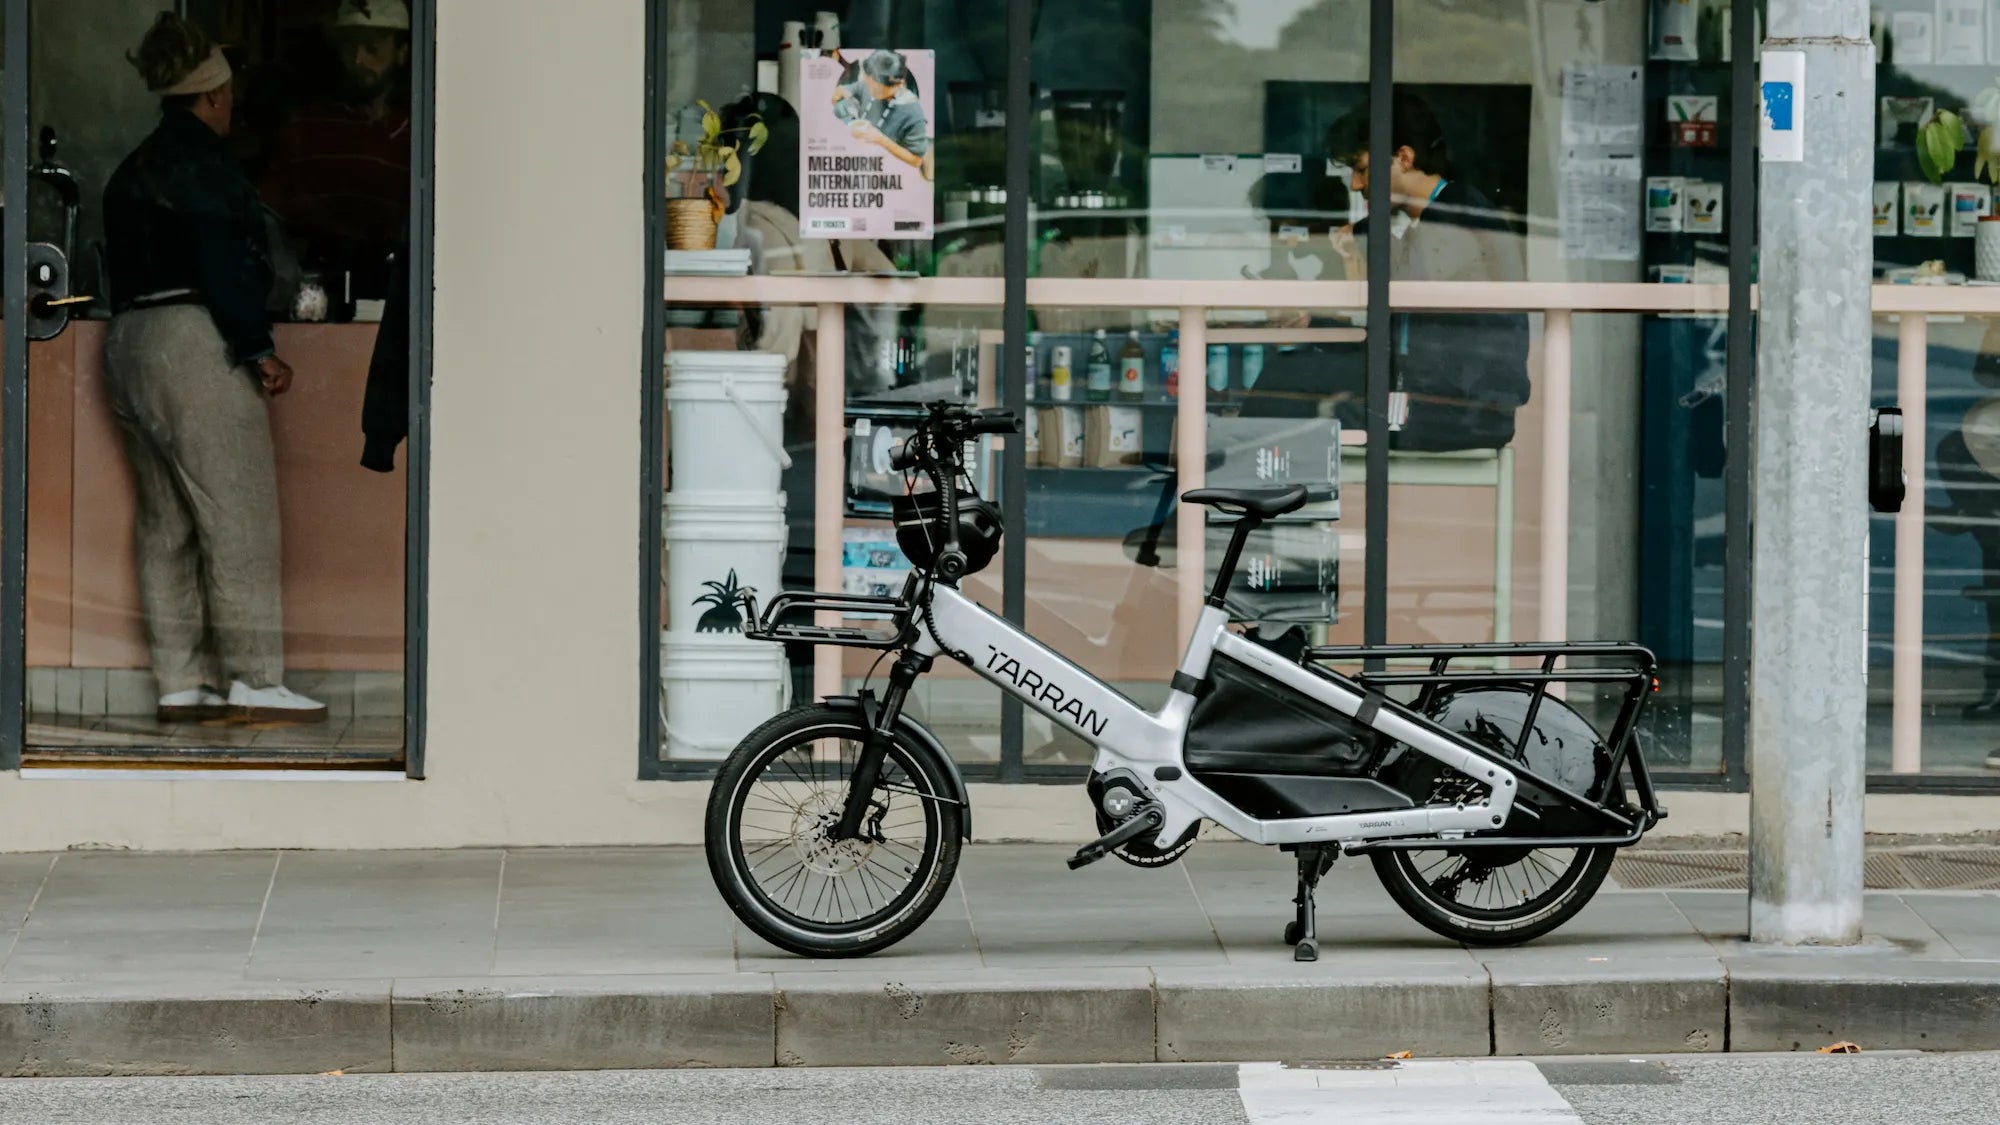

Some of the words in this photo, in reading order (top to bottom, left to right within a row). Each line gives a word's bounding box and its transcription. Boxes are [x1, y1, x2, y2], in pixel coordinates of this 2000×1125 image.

[808, 156, 884, 172] MELBOURNE
[808, 174, 903, 190] INTERNATIONAL
[808, 192, 849, 208] COFFEE
[852, 192, 884, 208] EXPO
[986, 644, 1109, 737] TARRAN
[1359, 821, 1391, 829] TARRAN
